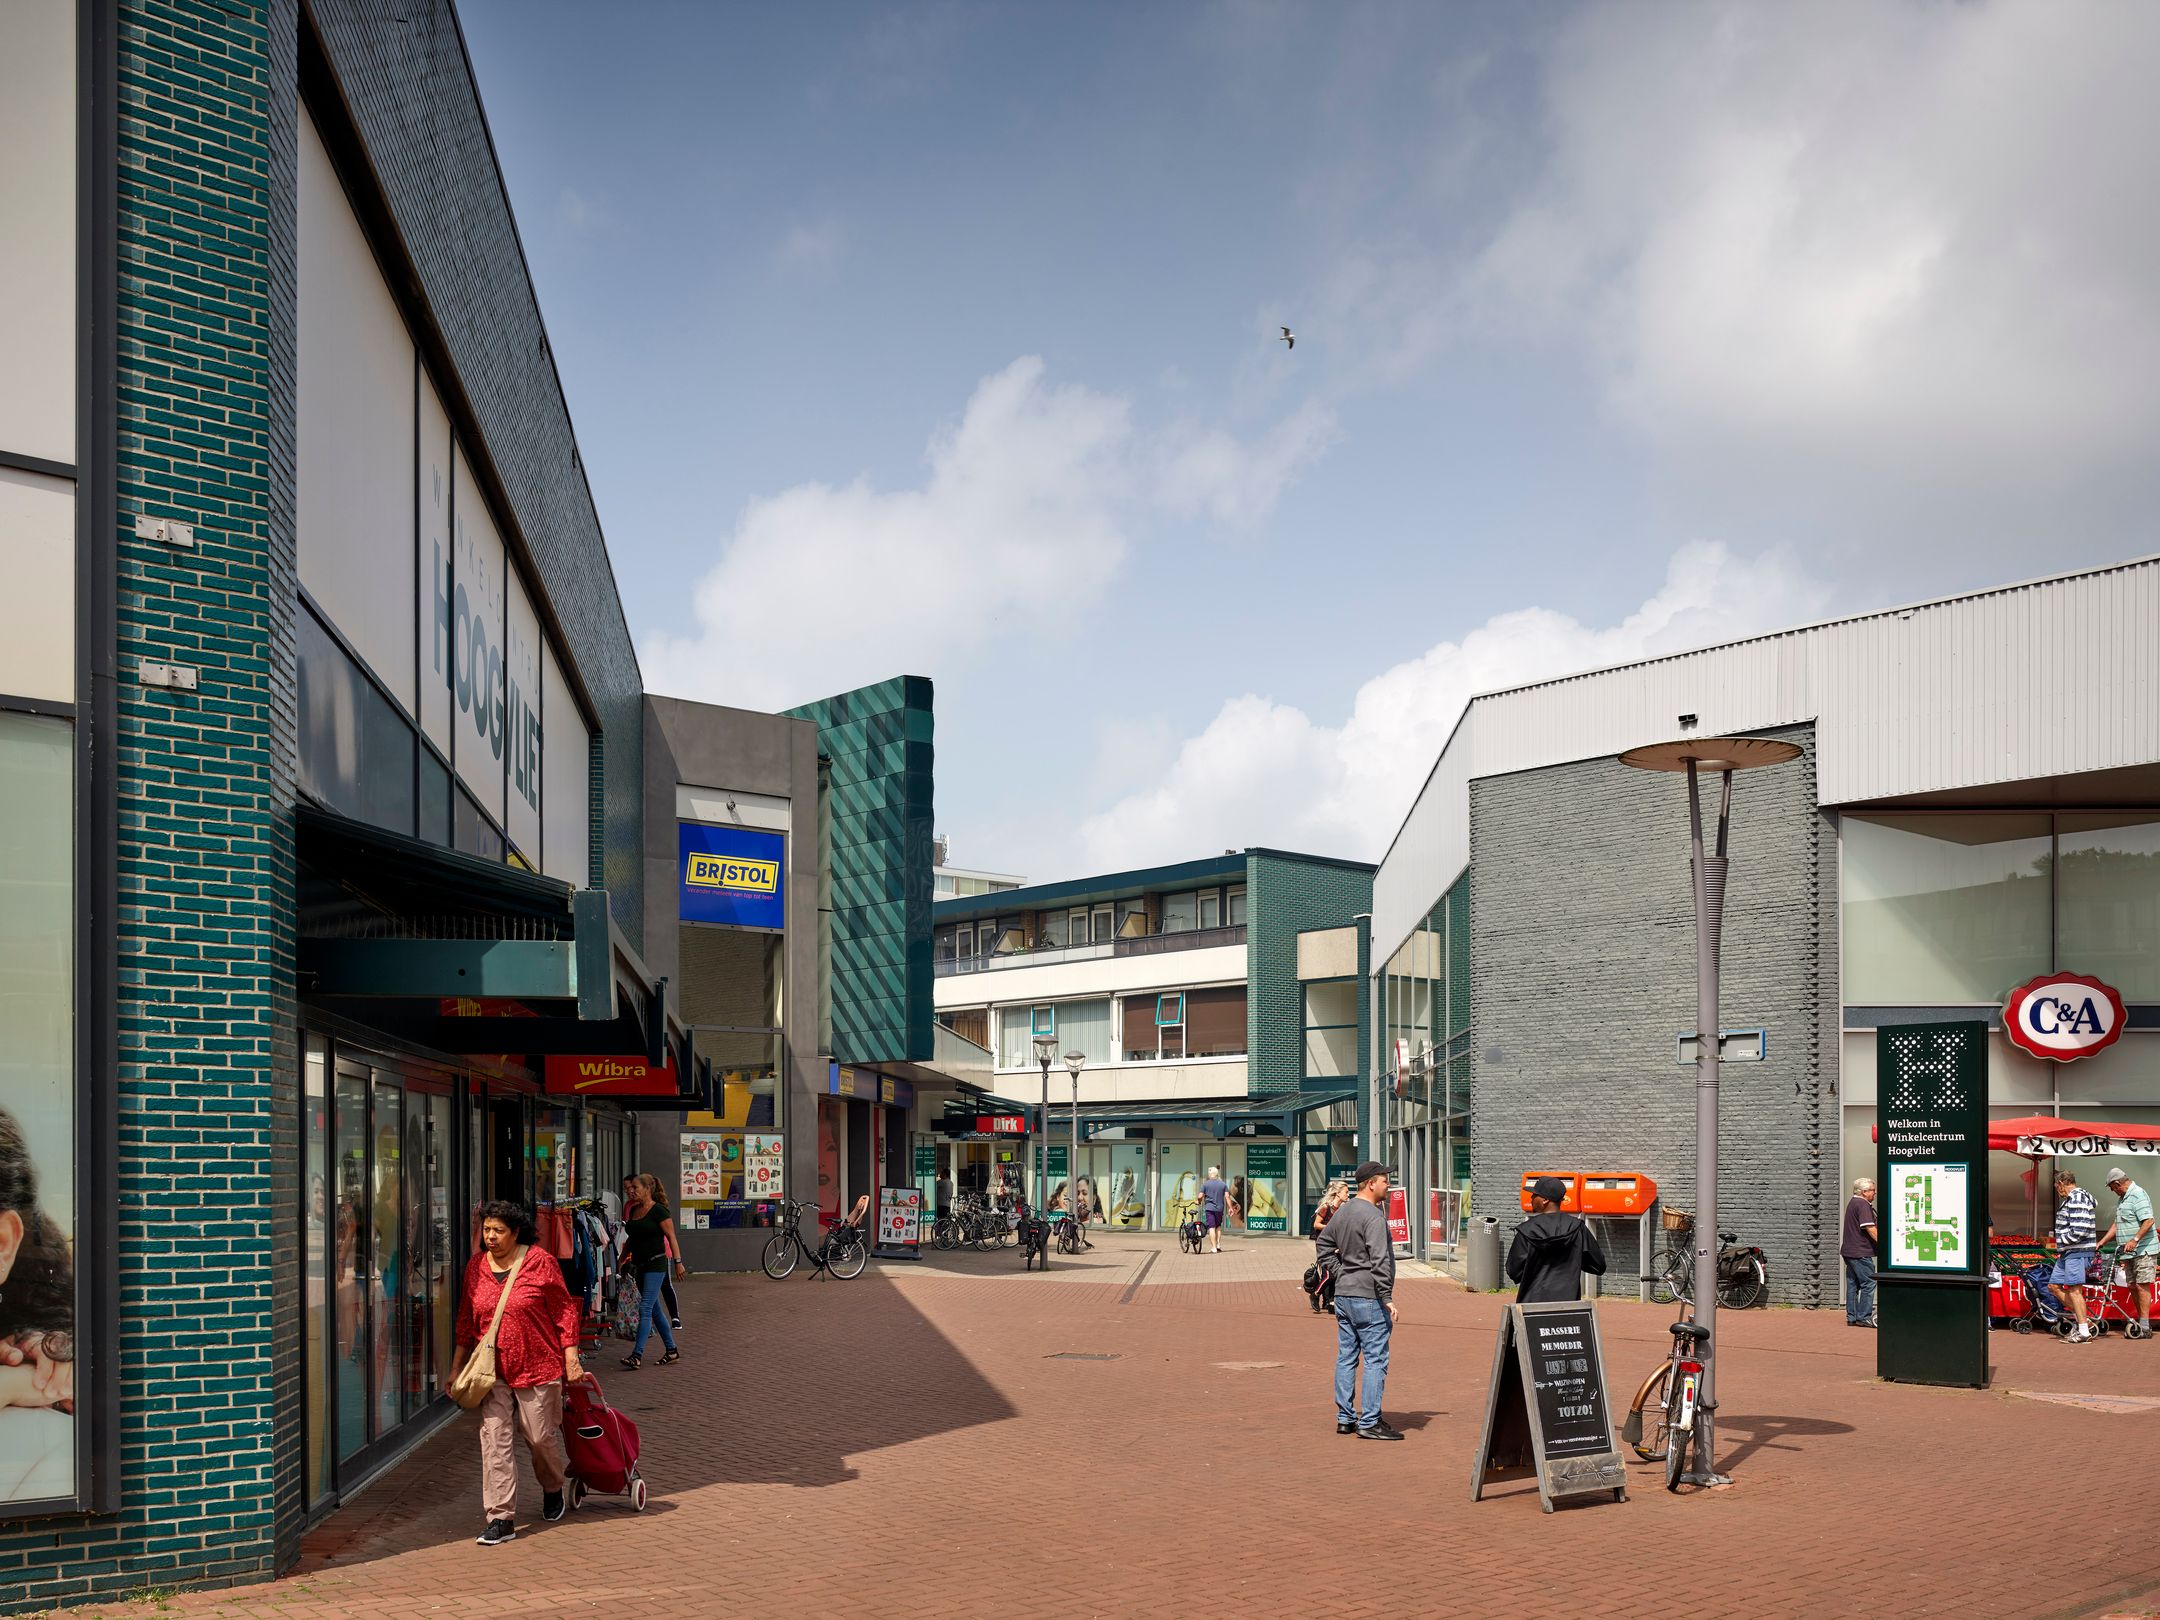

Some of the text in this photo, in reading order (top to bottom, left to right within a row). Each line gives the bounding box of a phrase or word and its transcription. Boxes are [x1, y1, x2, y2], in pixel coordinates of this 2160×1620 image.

[2029, 997, 2105, 1035] C&A
[578, 1059, 646, 1077] Wibra
[993, 1117, 1018, 1131] Dirk
[1888, 1119, 1941, 1128] Welkom in
[1888, 1132, 1965, 1141] Winkelcentrum
[2030, 1137, 2044, 1153] 2
[2126, 1139, 2138, 1152] €
[1888, 1146, 1936, 1157] Hoogvliet
[1250, 1221, 1283, 1229] HOOGVLIET
[1539, 1326, 1581, 1337] BRASSERIE
